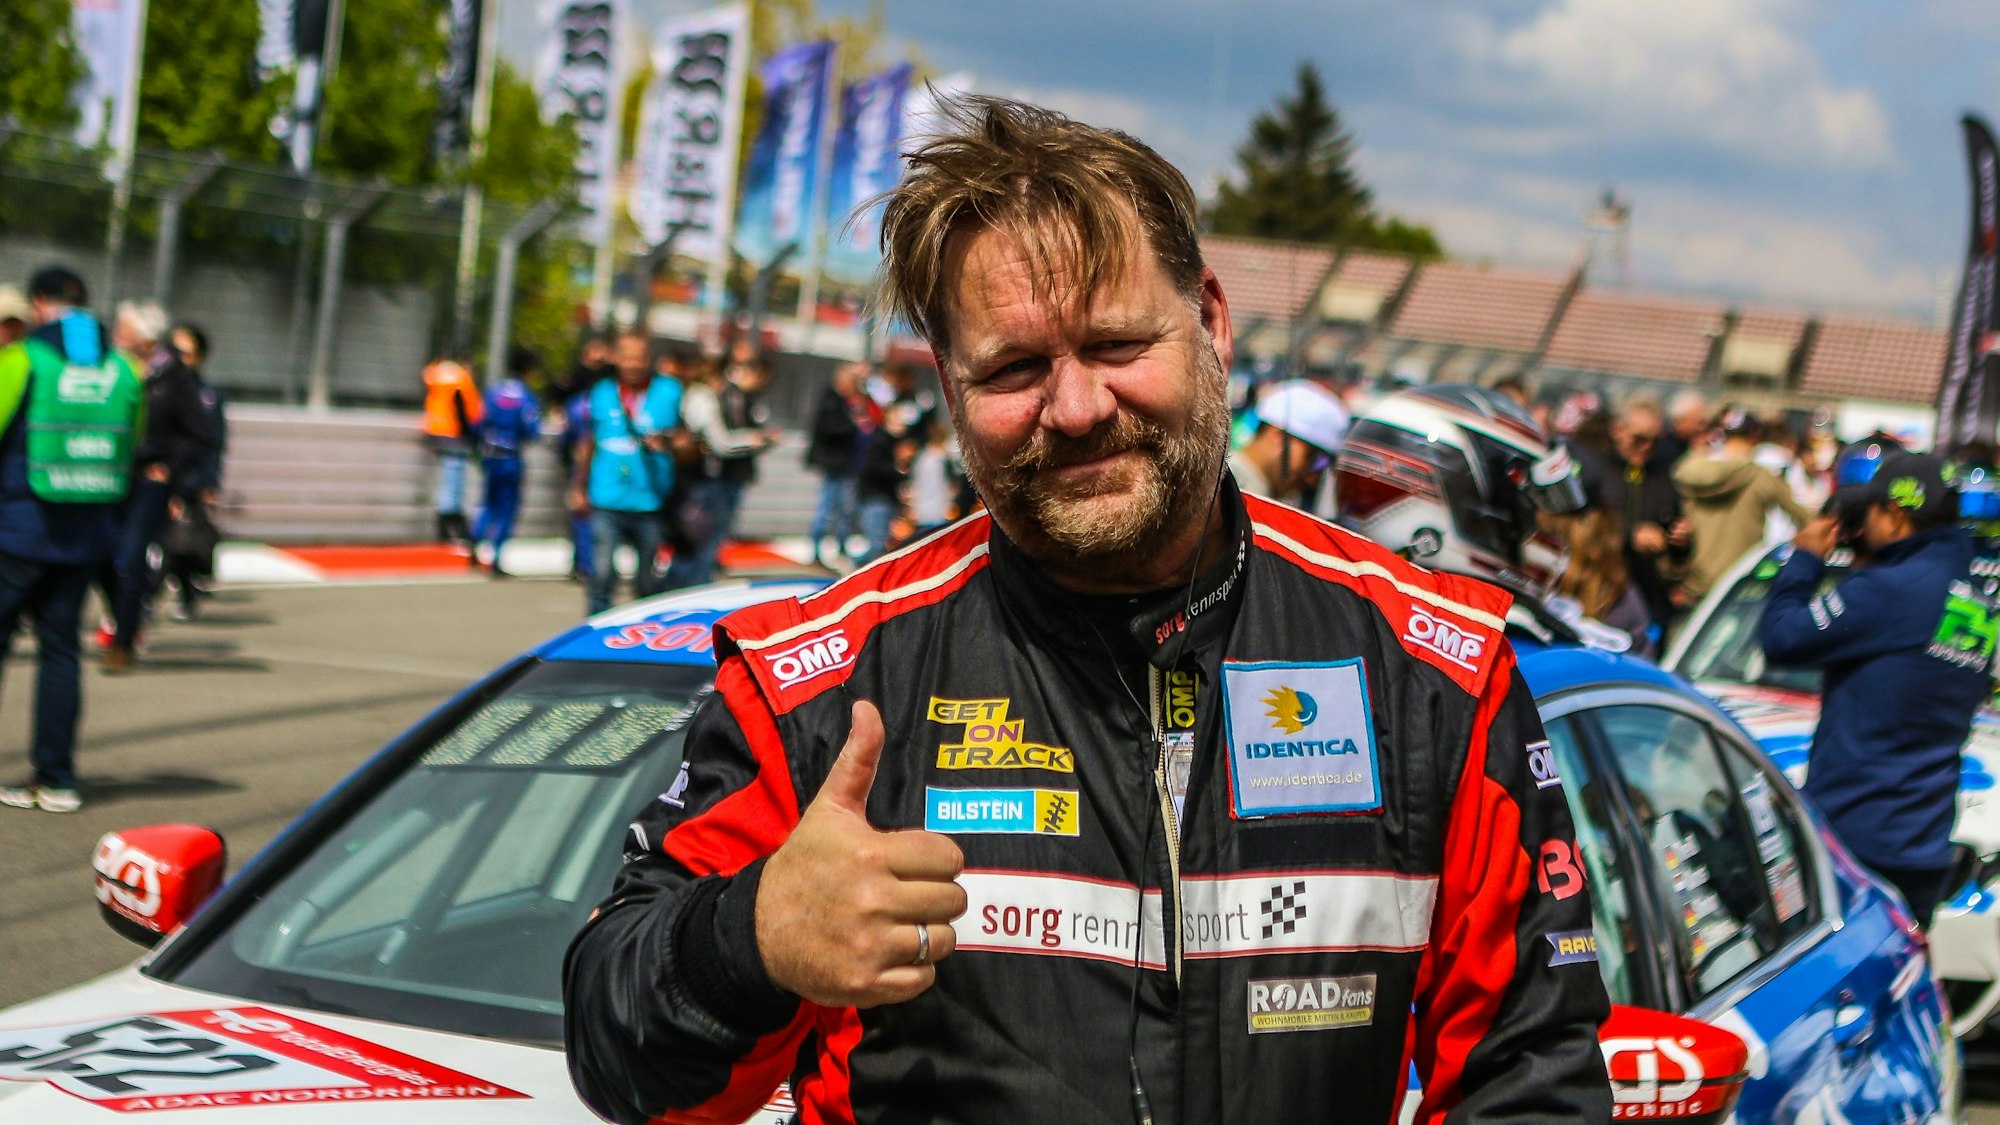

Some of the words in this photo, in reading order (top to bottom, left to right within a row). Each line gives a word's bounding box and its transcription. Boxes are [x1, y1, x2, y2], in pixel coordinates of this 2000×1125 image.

[1408, 613, 1482, 661] OMP
[772, 636, 849, 681] OMP
[934, 702, 1005, 720] GET
[1172, 670, 1195, 728] OMP
[968, 724, 1020, 743] ON
[943, 747, 1073, 770] TRACK
[1246, 738, 1359, 760] IDENTICA
[1249, 771, 1362, 789] www.identica.de
[937, 801, 1023, 820] BILSTEIN
[982, 904, 1063, 948] sorg
[1251, 981, 1342, 1012] ROAD
[1341, 989, 1373, 1008] fans
[275, 1031, 438, 1086] TotalEnergies
[122, 1092, 242, 1112] ADAC
[250, 1084, 500, 1103] NORDRHEIN
